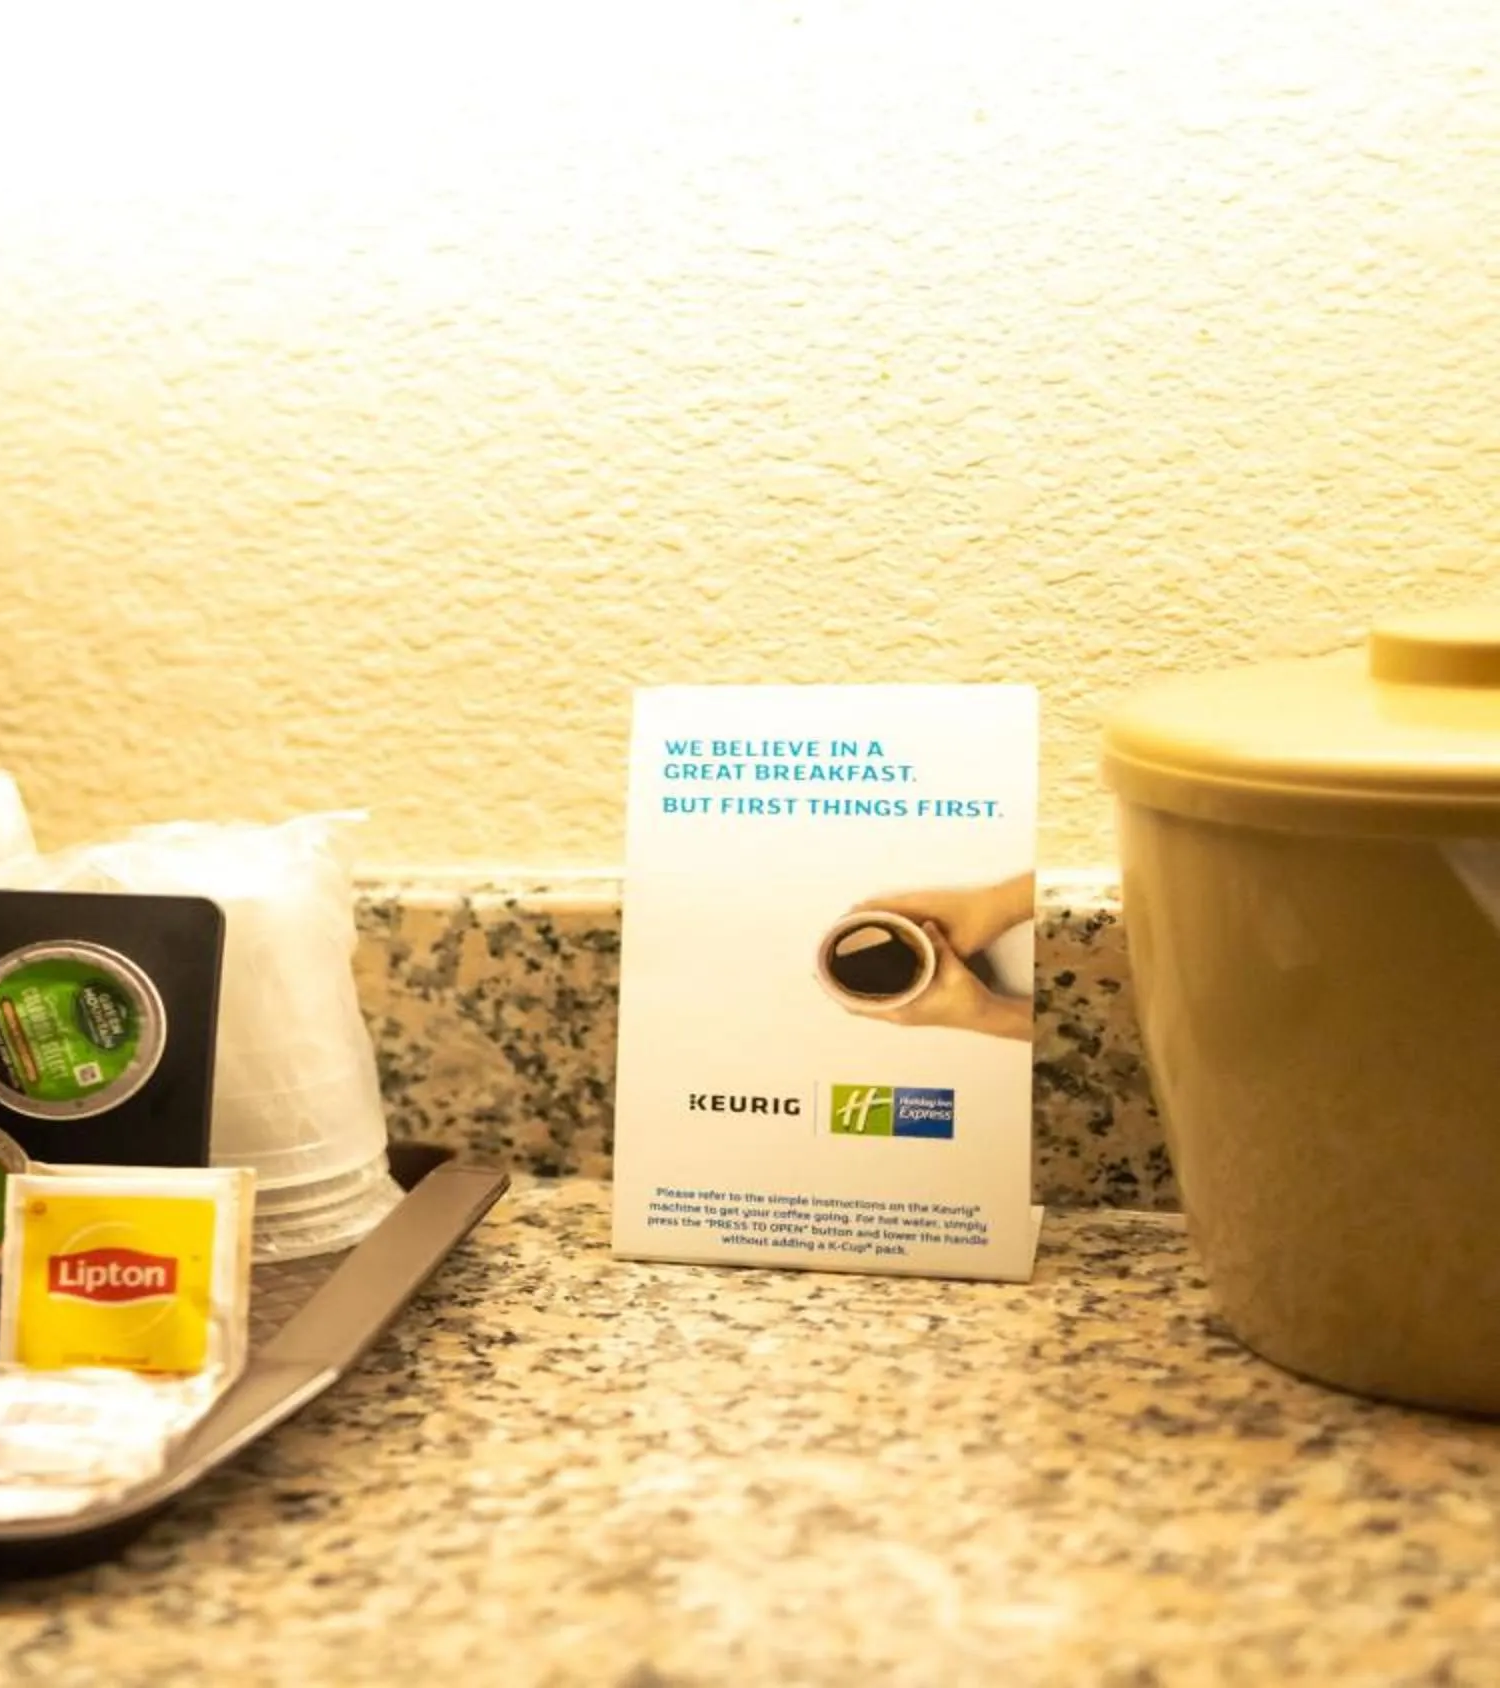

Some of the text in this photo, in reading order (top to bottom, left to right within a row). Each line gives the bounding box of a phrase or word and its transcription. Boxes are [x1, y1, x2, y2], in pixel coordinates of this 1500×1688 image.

[665, 740, 885, 757] WE BELIEVE IN A
[664, 763, 917, 783] GREAT BREAKFAST.
[662, 797, 1004, 819] BUT FIRST THINGS FIRST.
[689, 1093, 801, 1116] KEURIG
[899, 1107, 952, 1120] Express
[656, 1187, 695, 1199] Please
[698, 1189, 726, 1200] refer
[729, 1191, 742, 1201] to
[745, 1193, 765, 1203] the
[768, 1194, 809, 1207] simple
[812, 1197, 886, 1211] instructions
[889, 1203, 904, 1212] on
[908, 1202, 928, 1213] the
[649, 1202, 701, 1213] machine
[704, 1204, 717, 1215] to
[719, 1206, 739, 1218] get
[742, 1208, 770, 1219] your
[773, 1209, 811, 1220] coffee
[855, 1213, 875, 1223] For
[878, 1215, 899, 1225] hot
[943, 1219, 987, 1233] simply
[647, 1216, 678, 1227] press
[682, 1216, 702, 1227] the
[752, 1221, 767, 1233] TO
[812, 1225, 853, 1237] button
[856, 1228, 880, 1239] and
[884, 1230, 917, 1241] lower
[920, 1232, 941, 1243] the
[943, 1233, 988, 1245] handle
[721, 1234, 769, 1247] without
[772, 1237, 815, 1251] adding
[58, 1260, 167, 1293] Lipton
